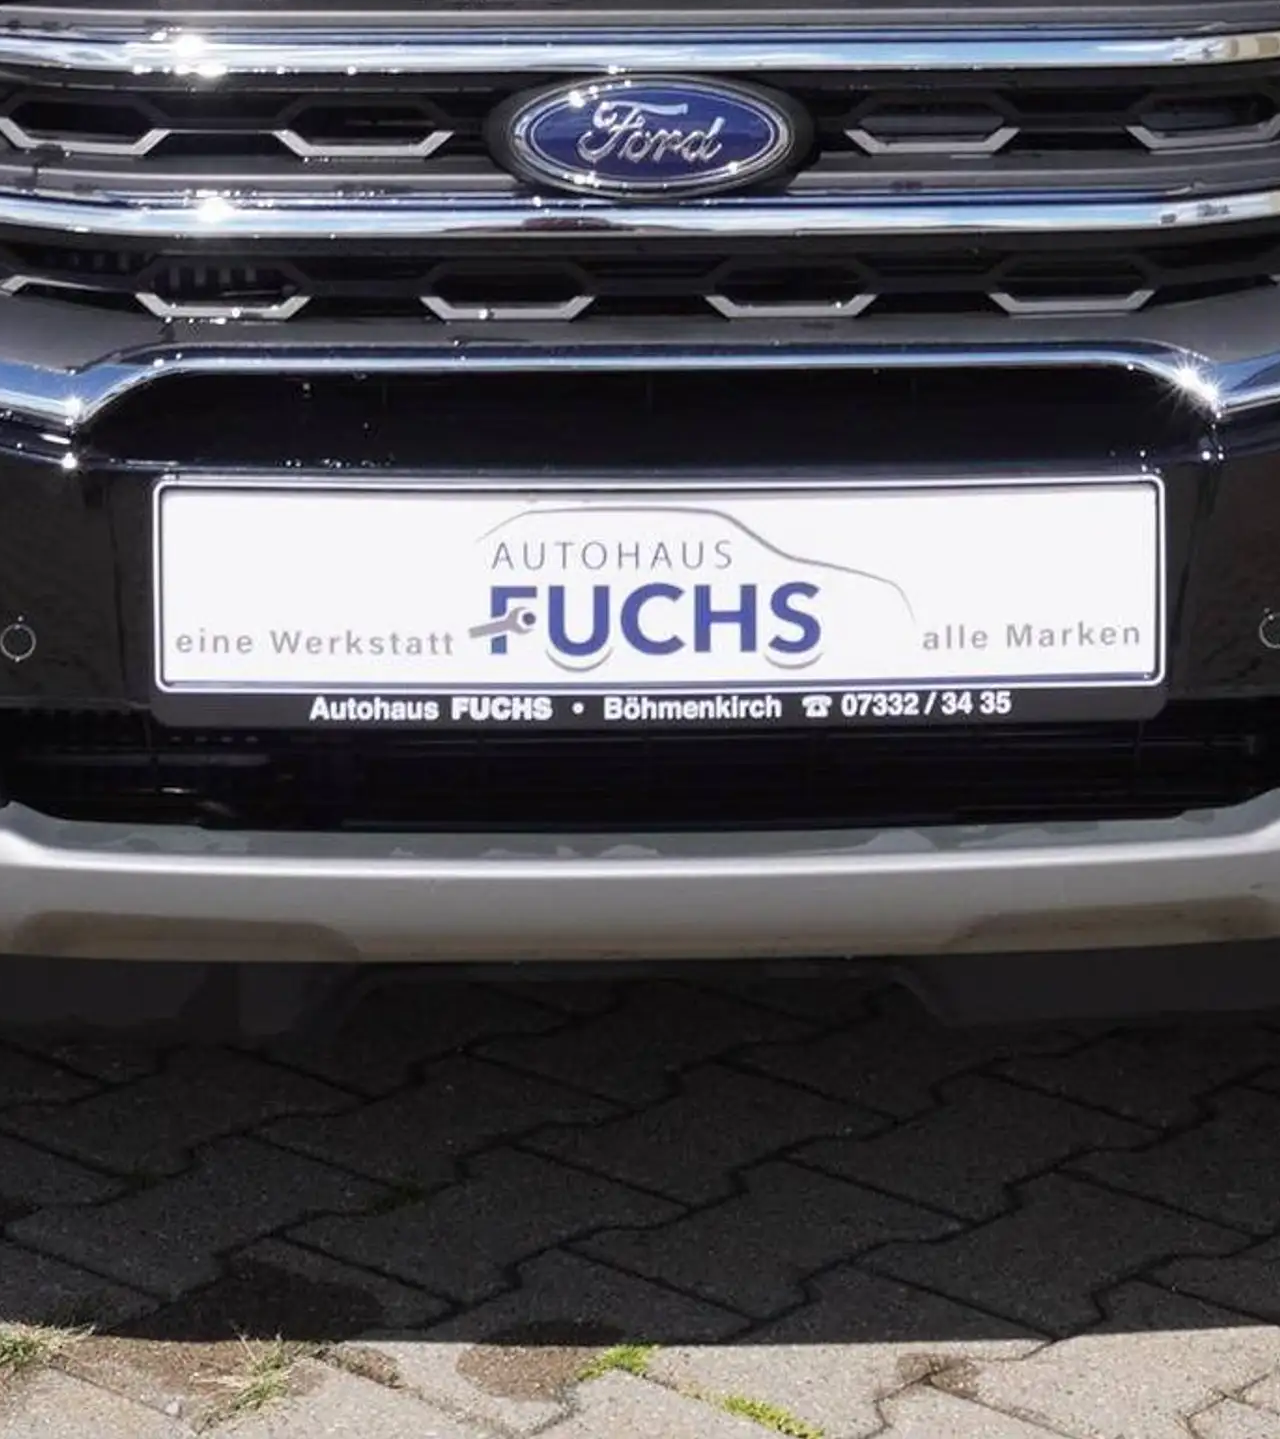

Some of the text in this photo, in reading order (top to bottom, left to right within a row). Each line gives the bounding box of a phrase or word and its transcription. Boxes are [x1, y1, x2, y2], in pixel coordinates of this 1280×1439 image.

[577, 100, 726, 163] Ford
[491, 539, 733, 570] AUTOHAUS
[490, 582, 822, 657] FUCHS
[175, 627, 454, 656] eine Werkstatt
[922, 620, 1142, 651] alle Marken
[309, 696, 440, 721] Autohaus
[451, 696, 554, 721] FUCHS
[603, 694, 783, 721] Böhmenkirch
[979, 690, 1012, 714] 35
